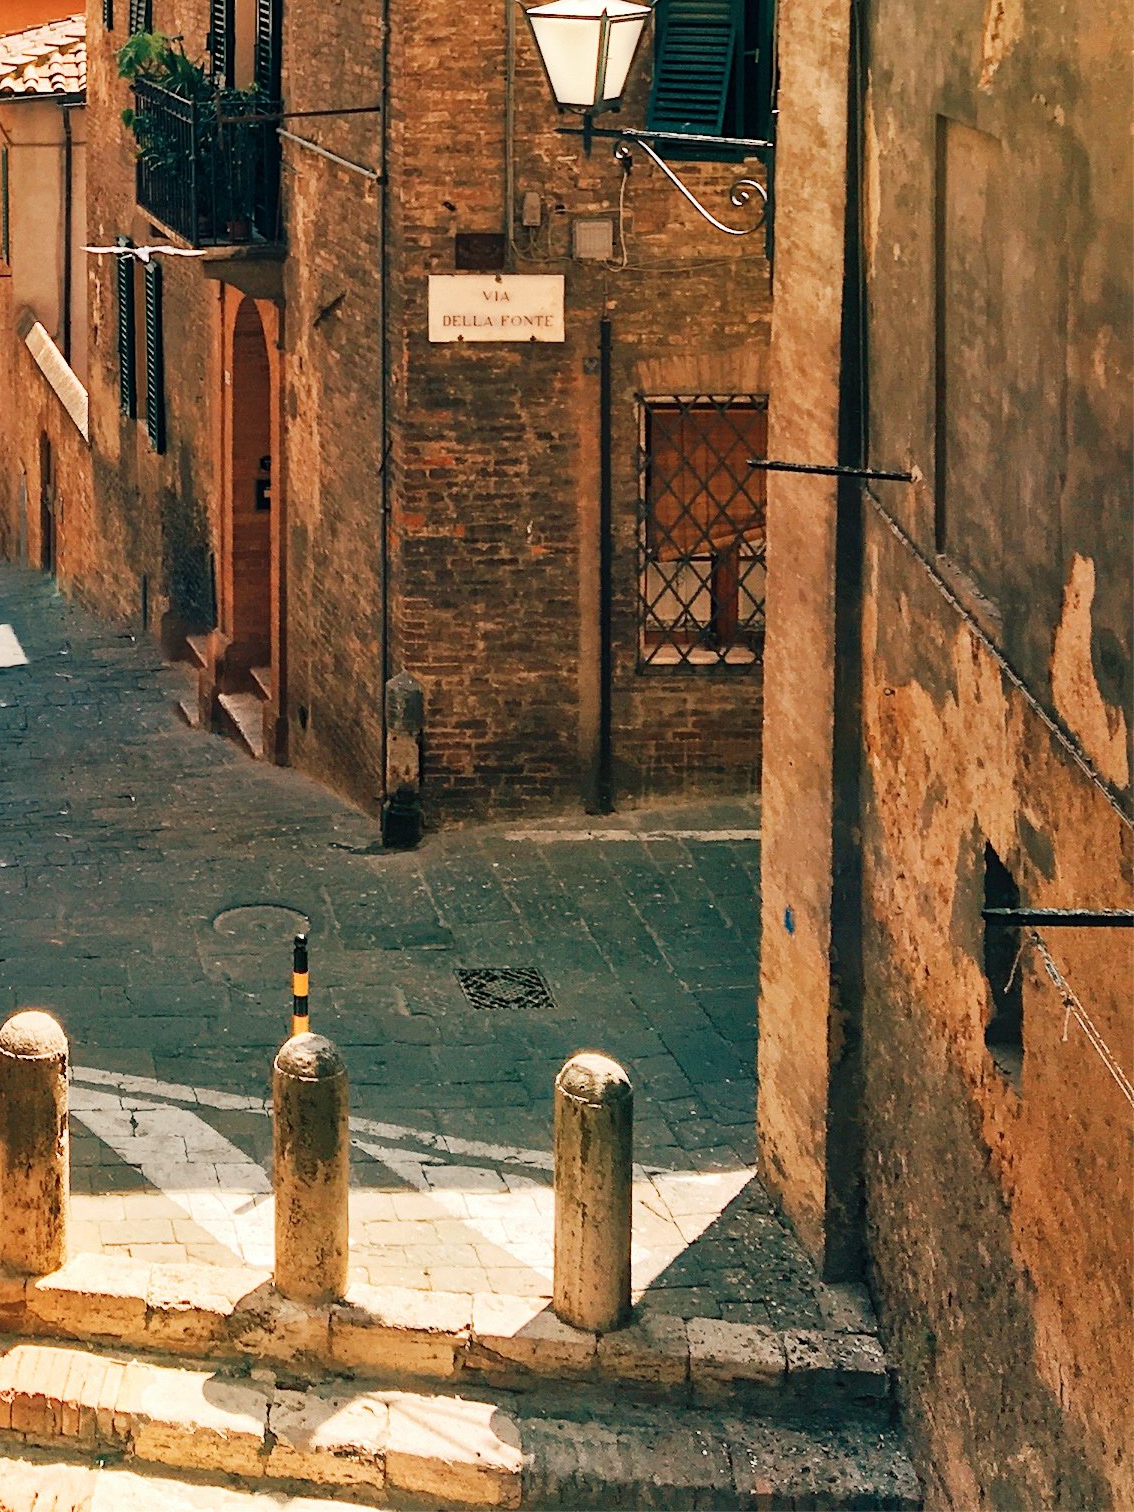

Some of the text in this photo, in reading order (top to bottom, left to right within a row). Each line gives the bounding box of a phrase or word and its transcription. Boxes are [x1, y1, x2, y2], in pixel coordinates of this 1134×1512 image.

[483, 291, 510, 301] VIA
[443, 315, 554, 327] DELLA FONTE
